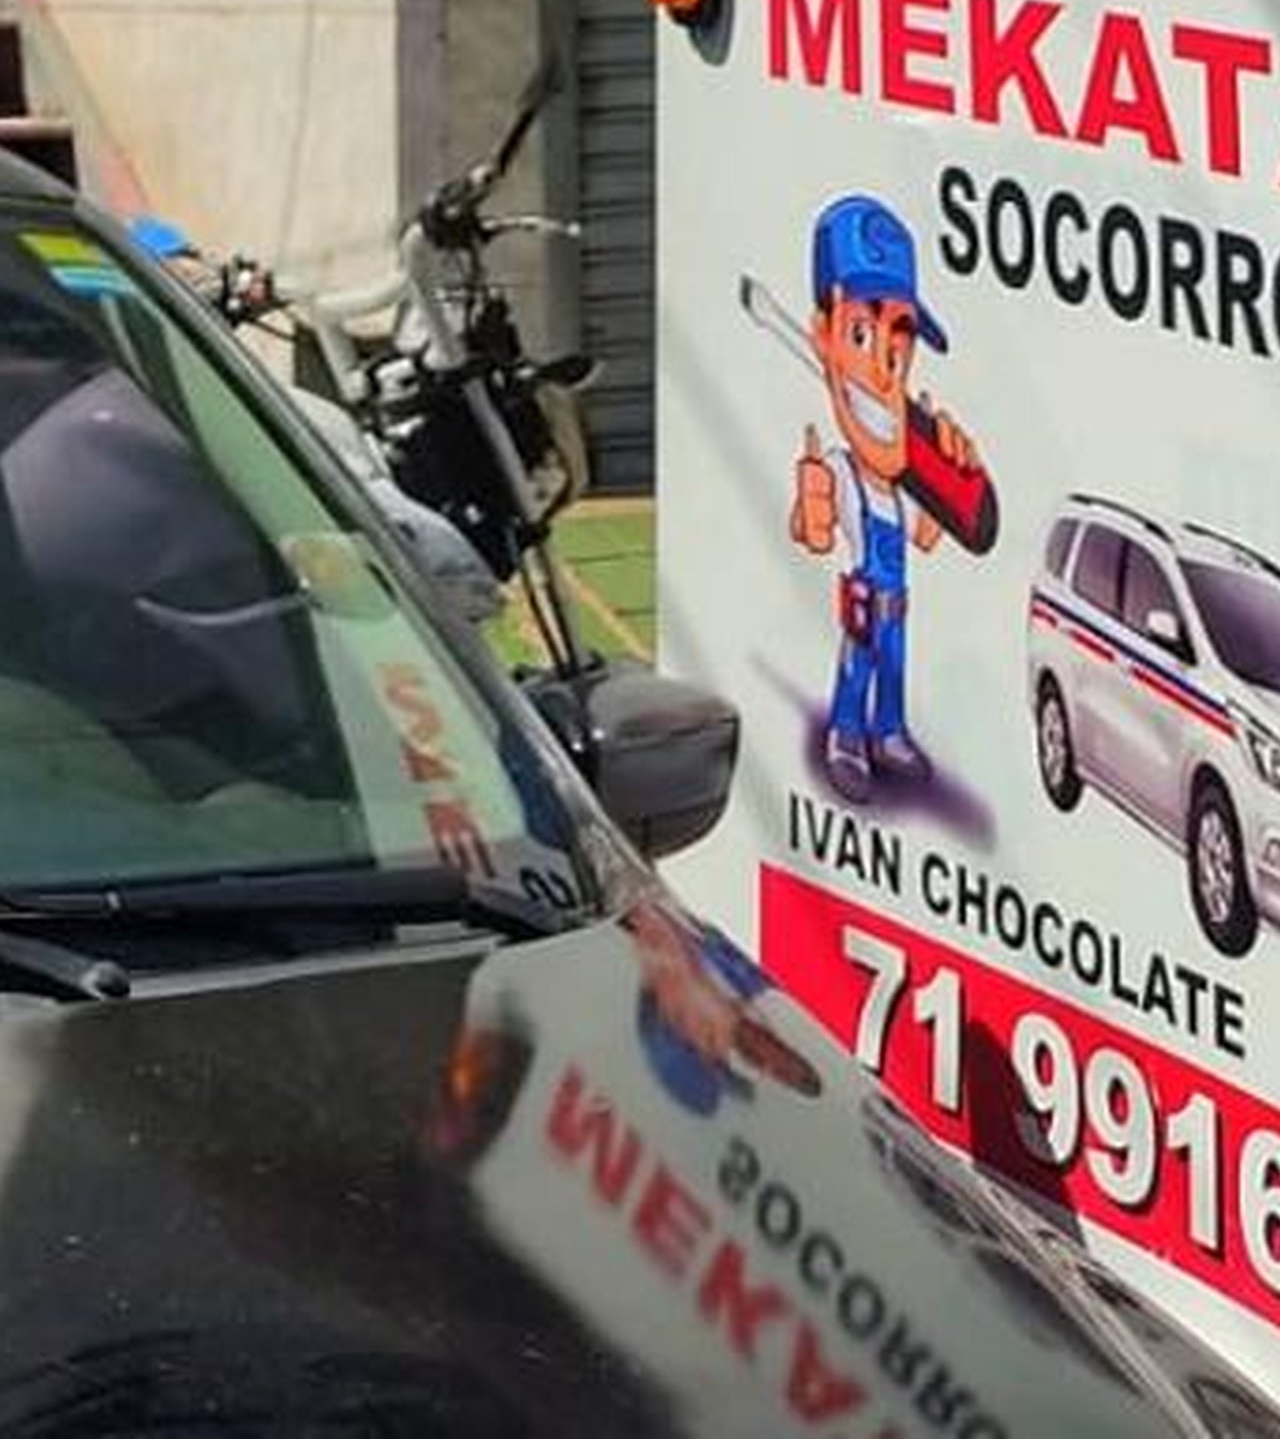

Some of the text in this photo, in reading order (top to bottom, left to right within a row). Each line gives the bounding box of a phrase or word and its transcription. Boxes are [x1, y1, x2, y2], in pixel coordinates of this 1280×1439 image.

[788, 794, 1248, 1059] IVAN CHOCOLATE
[842, 925, 963, 1113] 71
